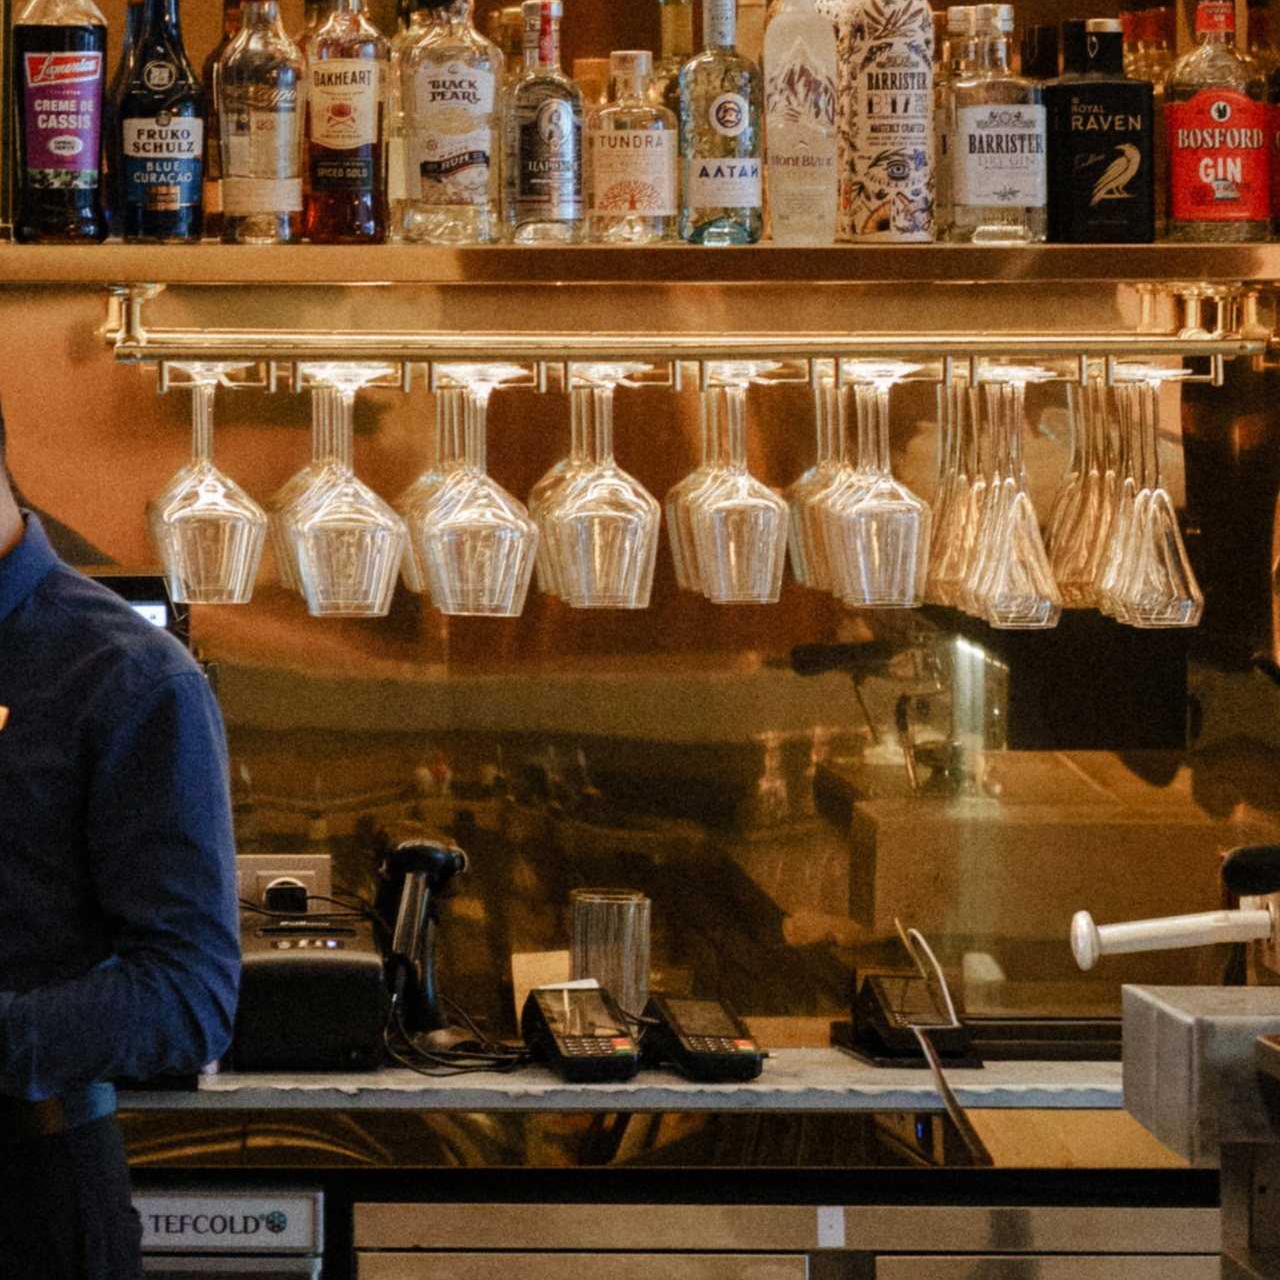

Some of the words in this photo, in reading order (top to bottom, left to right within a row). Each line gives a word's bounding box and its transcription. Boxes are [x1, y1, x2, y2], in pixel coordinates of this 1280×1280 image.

[314, 69, 373, 88] OAKHEART
[428, 78, 480, 90] BLACK
[867, 72, 928, 90] BARRISTER
[429, 90, 482, 104] PEARL
[34, 99, 77, 112] CREME
[80, 99, 94, 112] DE
[1071, 105, 1105, 114] ROYAL
[37, 115, 91, 129] CASSIS
[1071, 115, 1142, 131] RAVEN
[136, 128, 191, 140] FRUKO
[1177, 128, 1264, 150] BOSFORD
[132, 141, 195, 153] SCHULZ
[599, 135, 664, 148] TUNDRA
[968, 134, 1044, 154] BARRISTER
[146, 161, 180, 172] BLUE
[440, 153, 470, 170] RUM
[771, 154, 800, 168] Mont
[977, 154, 1005, 167] DRY
[1008, 154, 1036, 167] GIN
[346, 167, 368, 178] GOLD
[699, 164, 760, 179] АЛТАЙ
[1199, 156, 1242, 184] GIN
[133, 171, 193, 186] CURAÇAO
[149, 1214, 261, 1235] TEFCOLD
